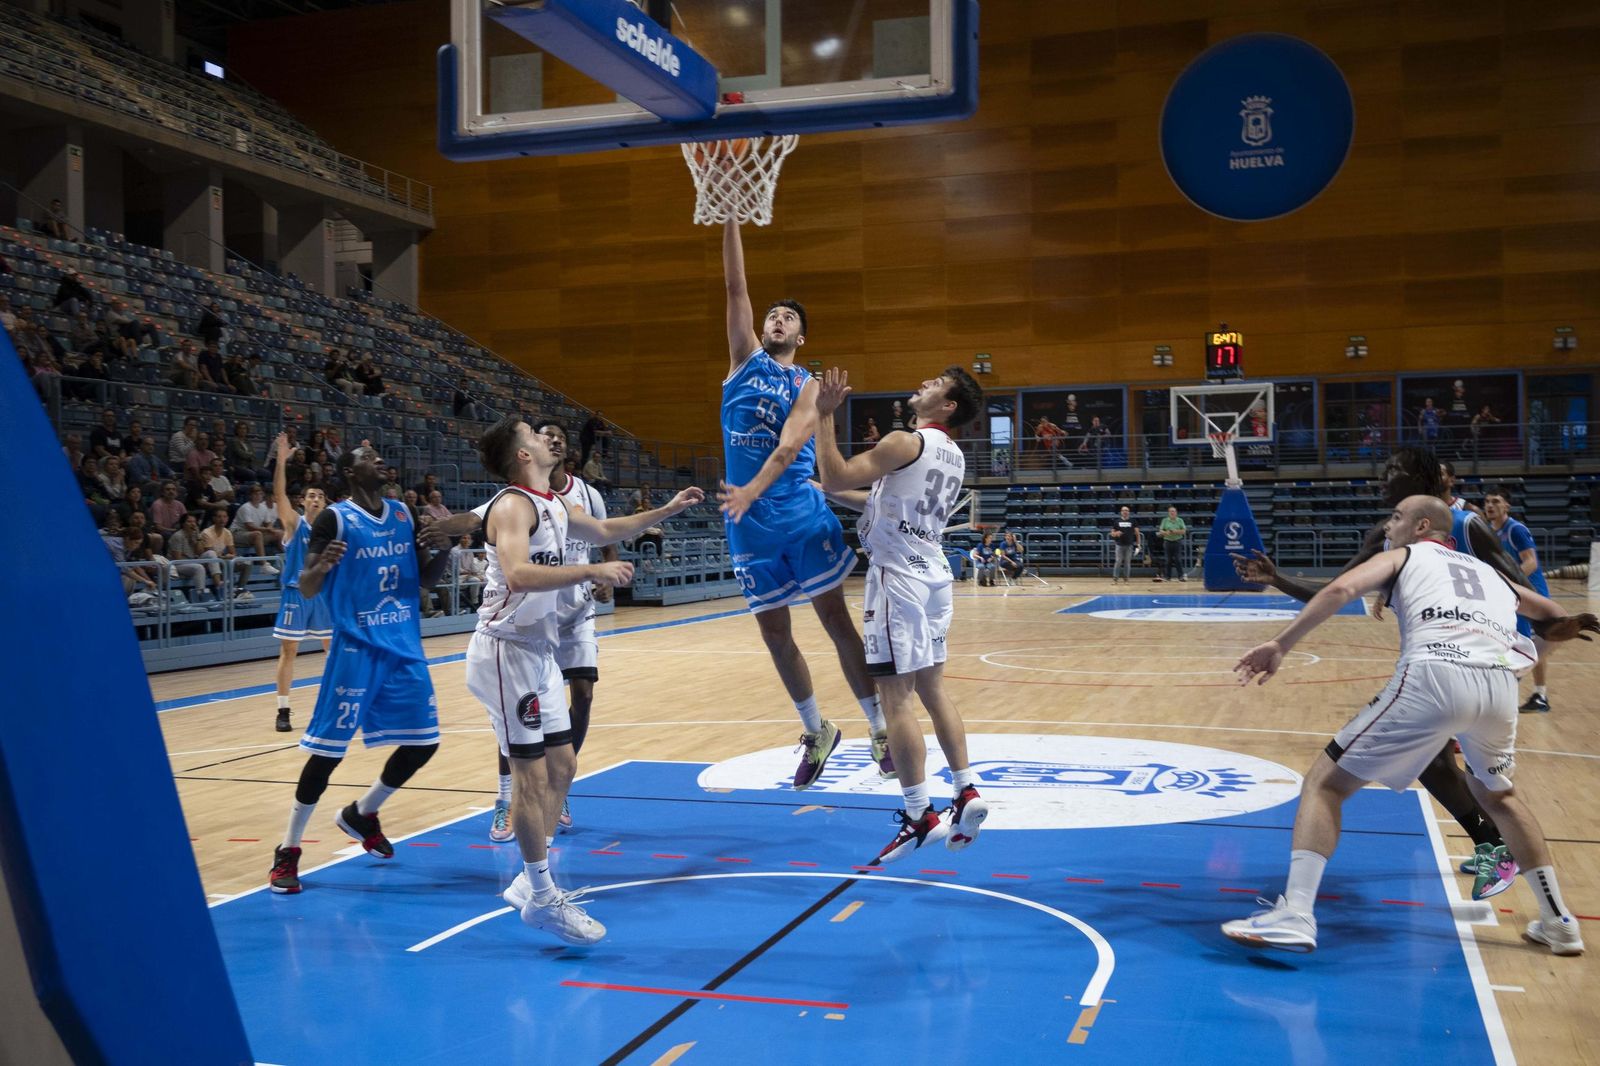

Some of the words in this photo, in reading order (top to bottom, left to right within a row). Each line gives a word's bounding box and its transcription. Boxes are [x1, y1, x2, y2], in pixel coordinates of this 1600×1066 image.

[615, 16, 681, 78] schelde
[1229, 155, 1285, 169] HUELVA
[1216, 346, 1235, 366] 17
[755, 397, 780, 425] 55
[936, 446, 963, 469] STULIC
[914, 468, 962, 522] 33
[378, 564, 400, 593] 23
[1447, 562, 1486, 601] 8
[283, 610, 294, 626] 11
[335, 701, 361, 730] 23
